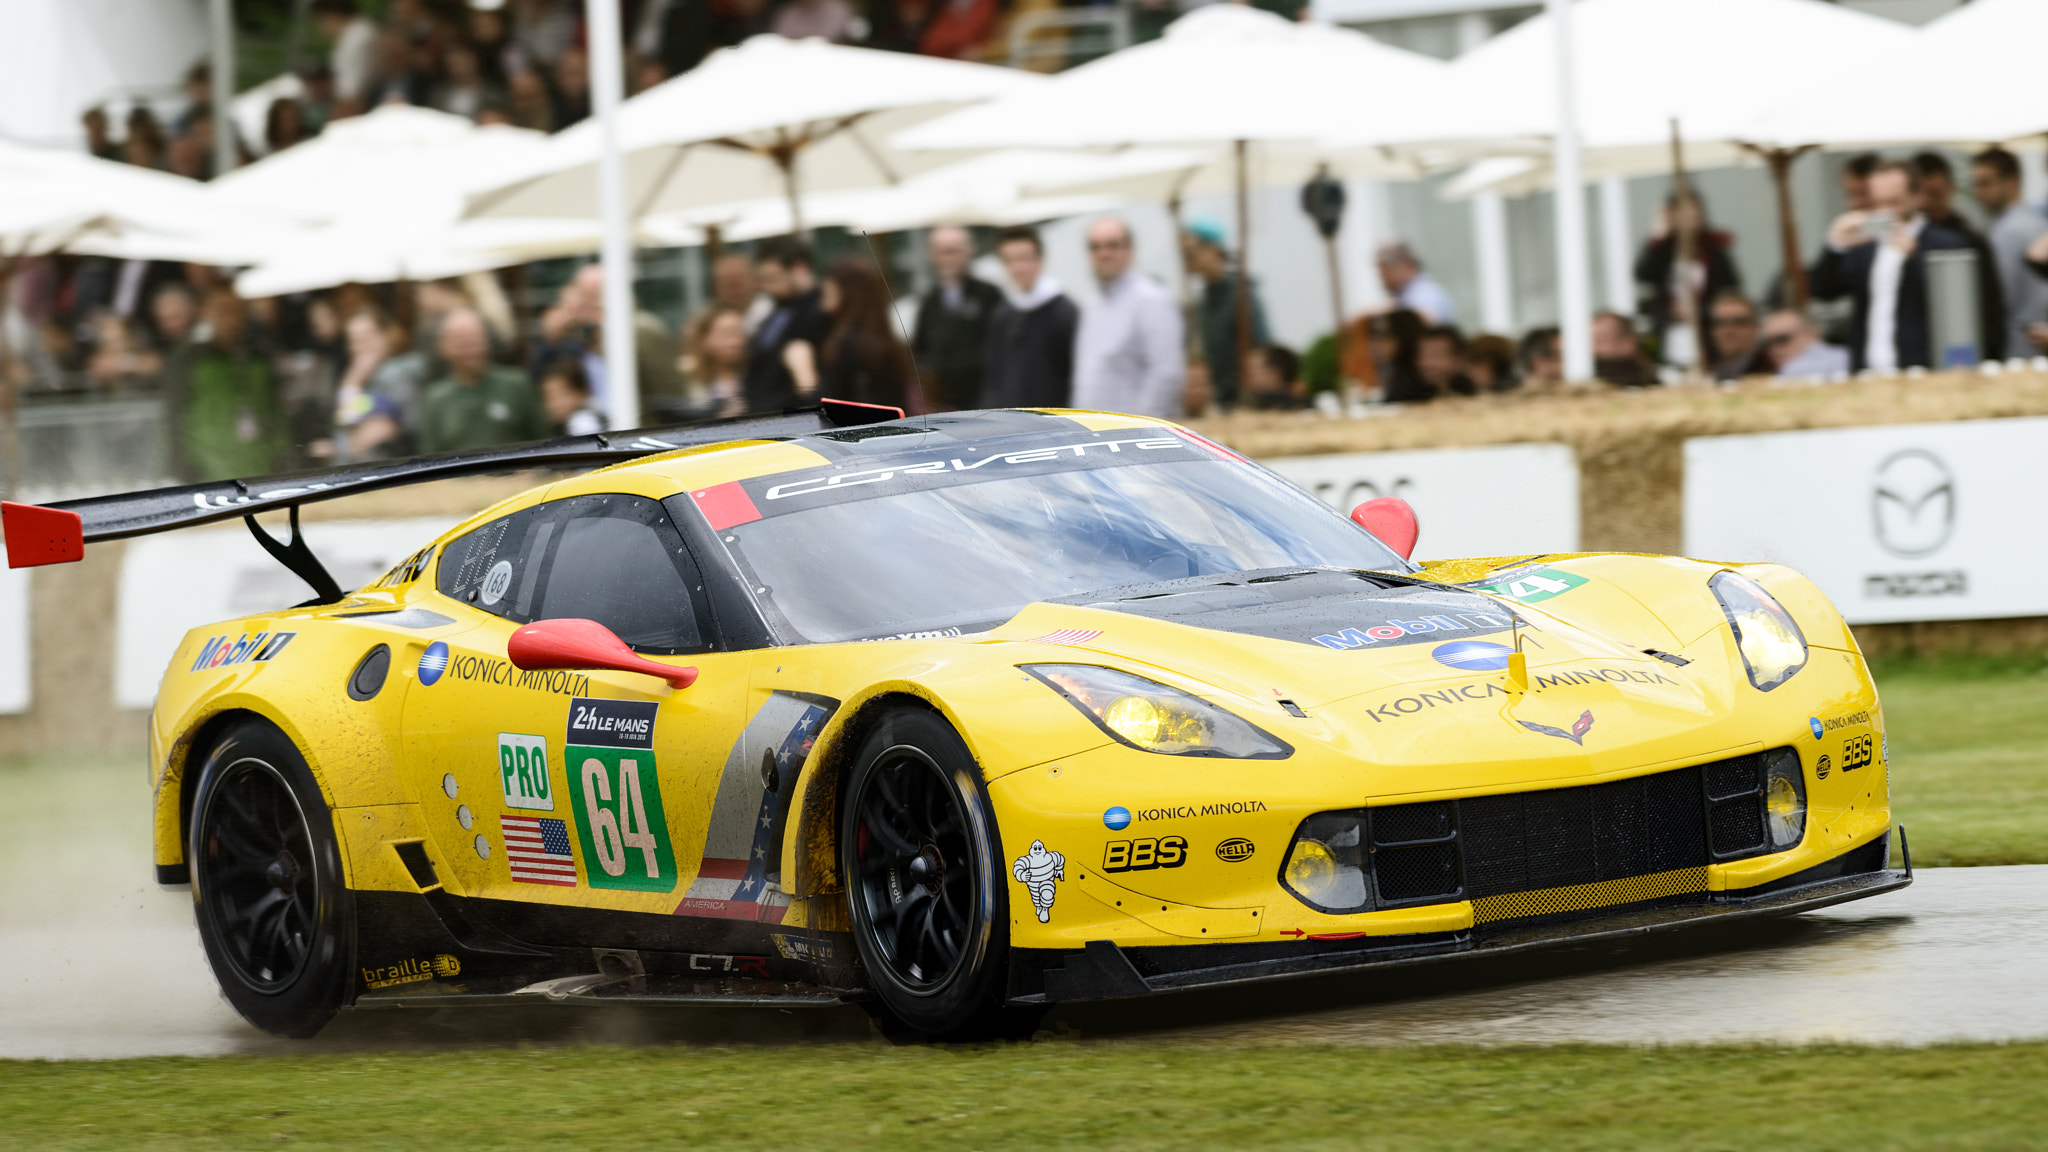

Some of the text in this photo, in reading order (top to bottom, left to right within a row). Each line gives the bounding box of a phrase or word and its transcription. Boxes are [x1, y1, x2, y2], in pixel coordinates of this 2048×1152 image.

[765, 437, 1185, 500] CORVETTE
[485, 571, 507, 594] 168
[1312, 614, 1468, 650] Mobil
[190, 632, 269, 673] Mobil
[450, 655, 589, 698] KONICA MINOLTA
[1366, 669, 1679, 723] KONICA MINOLTA
[572, 706, 649, 733] 24h LE MANS
[1823, 711, 1870, 731] KONICA MINOLTA
[1841, 733, 1872, 772] BBS
[500, 744, 549, 800] PRO
[581, 758, 660, 878] 64
[1138, 801, 1267, 821] KONICA MINOLTA
[1102, 835, 1188, 873] BBS
[1218, 842, 1255, 856] HELLA
[684, 900, 725, 910] AMERICA
[362, 958, 431, 982] braille
